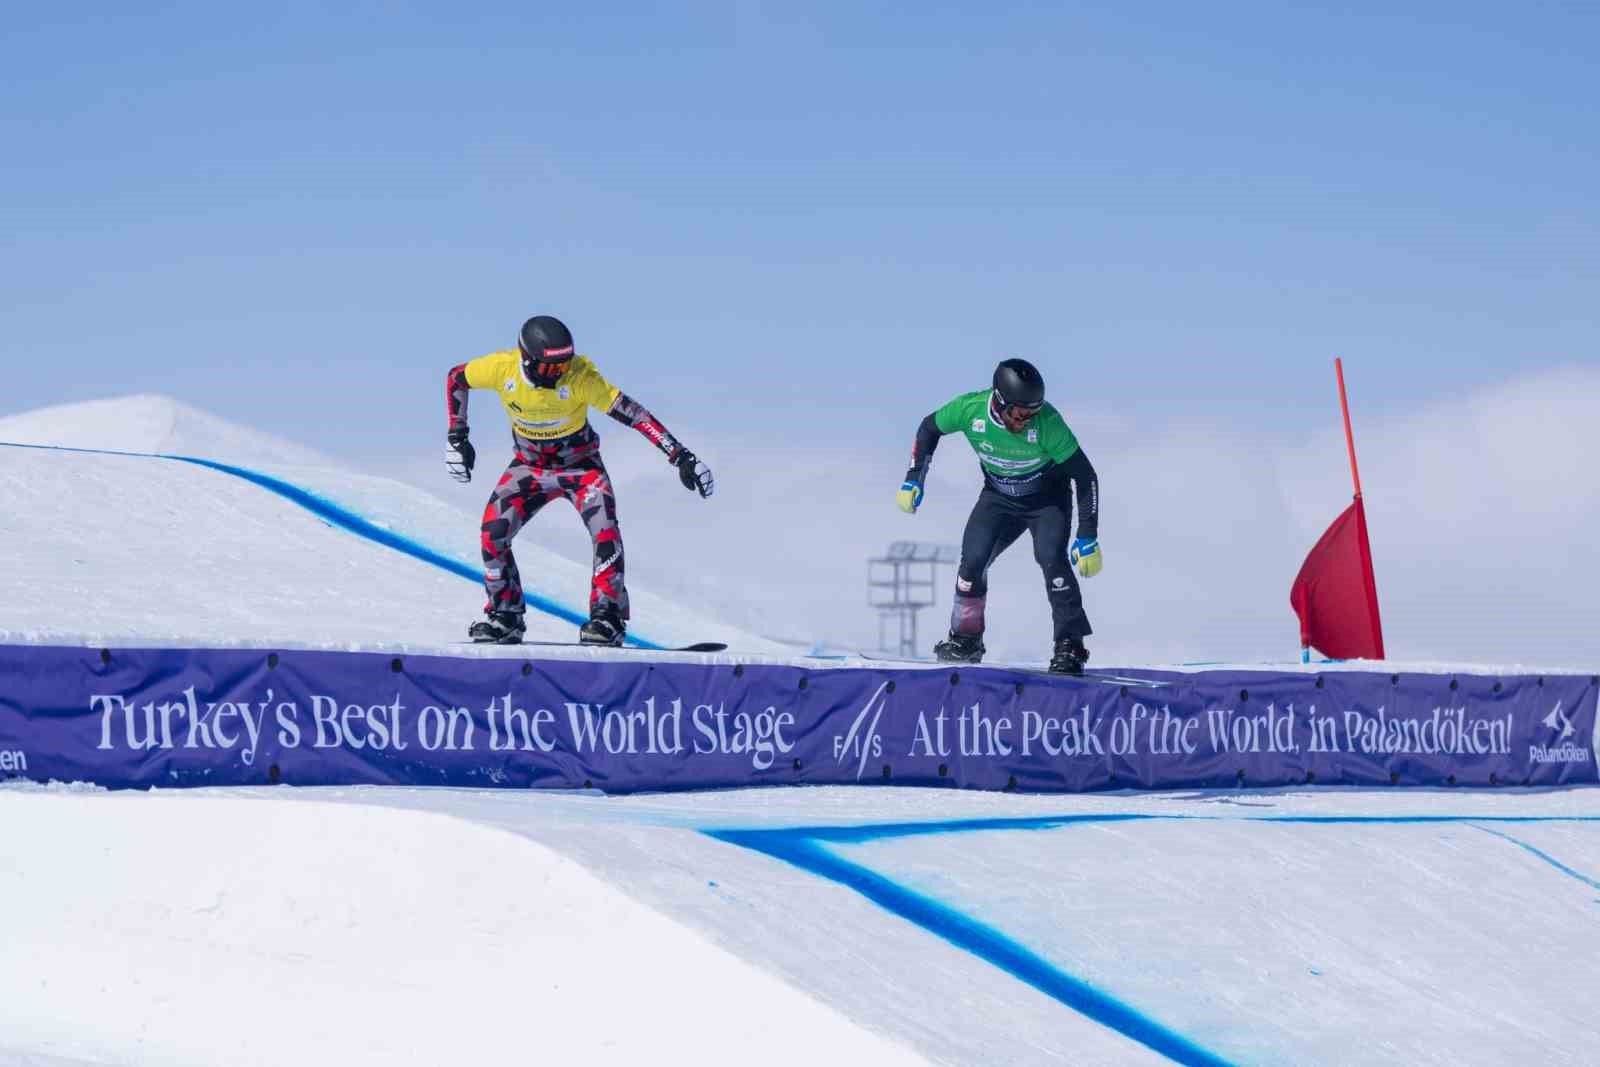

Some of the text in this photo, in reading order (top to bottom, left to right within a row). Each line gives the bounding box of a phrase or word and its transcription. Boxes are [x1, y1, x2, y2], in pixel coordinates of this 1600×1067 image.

[90, 685, 796, 769] Turkey's Best on the World Stage
[908, 705, 951, 757] At
[957, 702, 1012, 757] the
[1021, 704, 1104, 757] Peak
[1110, 702, 1147, 755] of
[1148, 702, 1199, 755] the
[1308, 704, 1339, 753] in
[1343, 705, 1513, 754] Palandöken!
[0, 750, 28, 770] en
[1529, 742, 1589, 764] Palandöken
